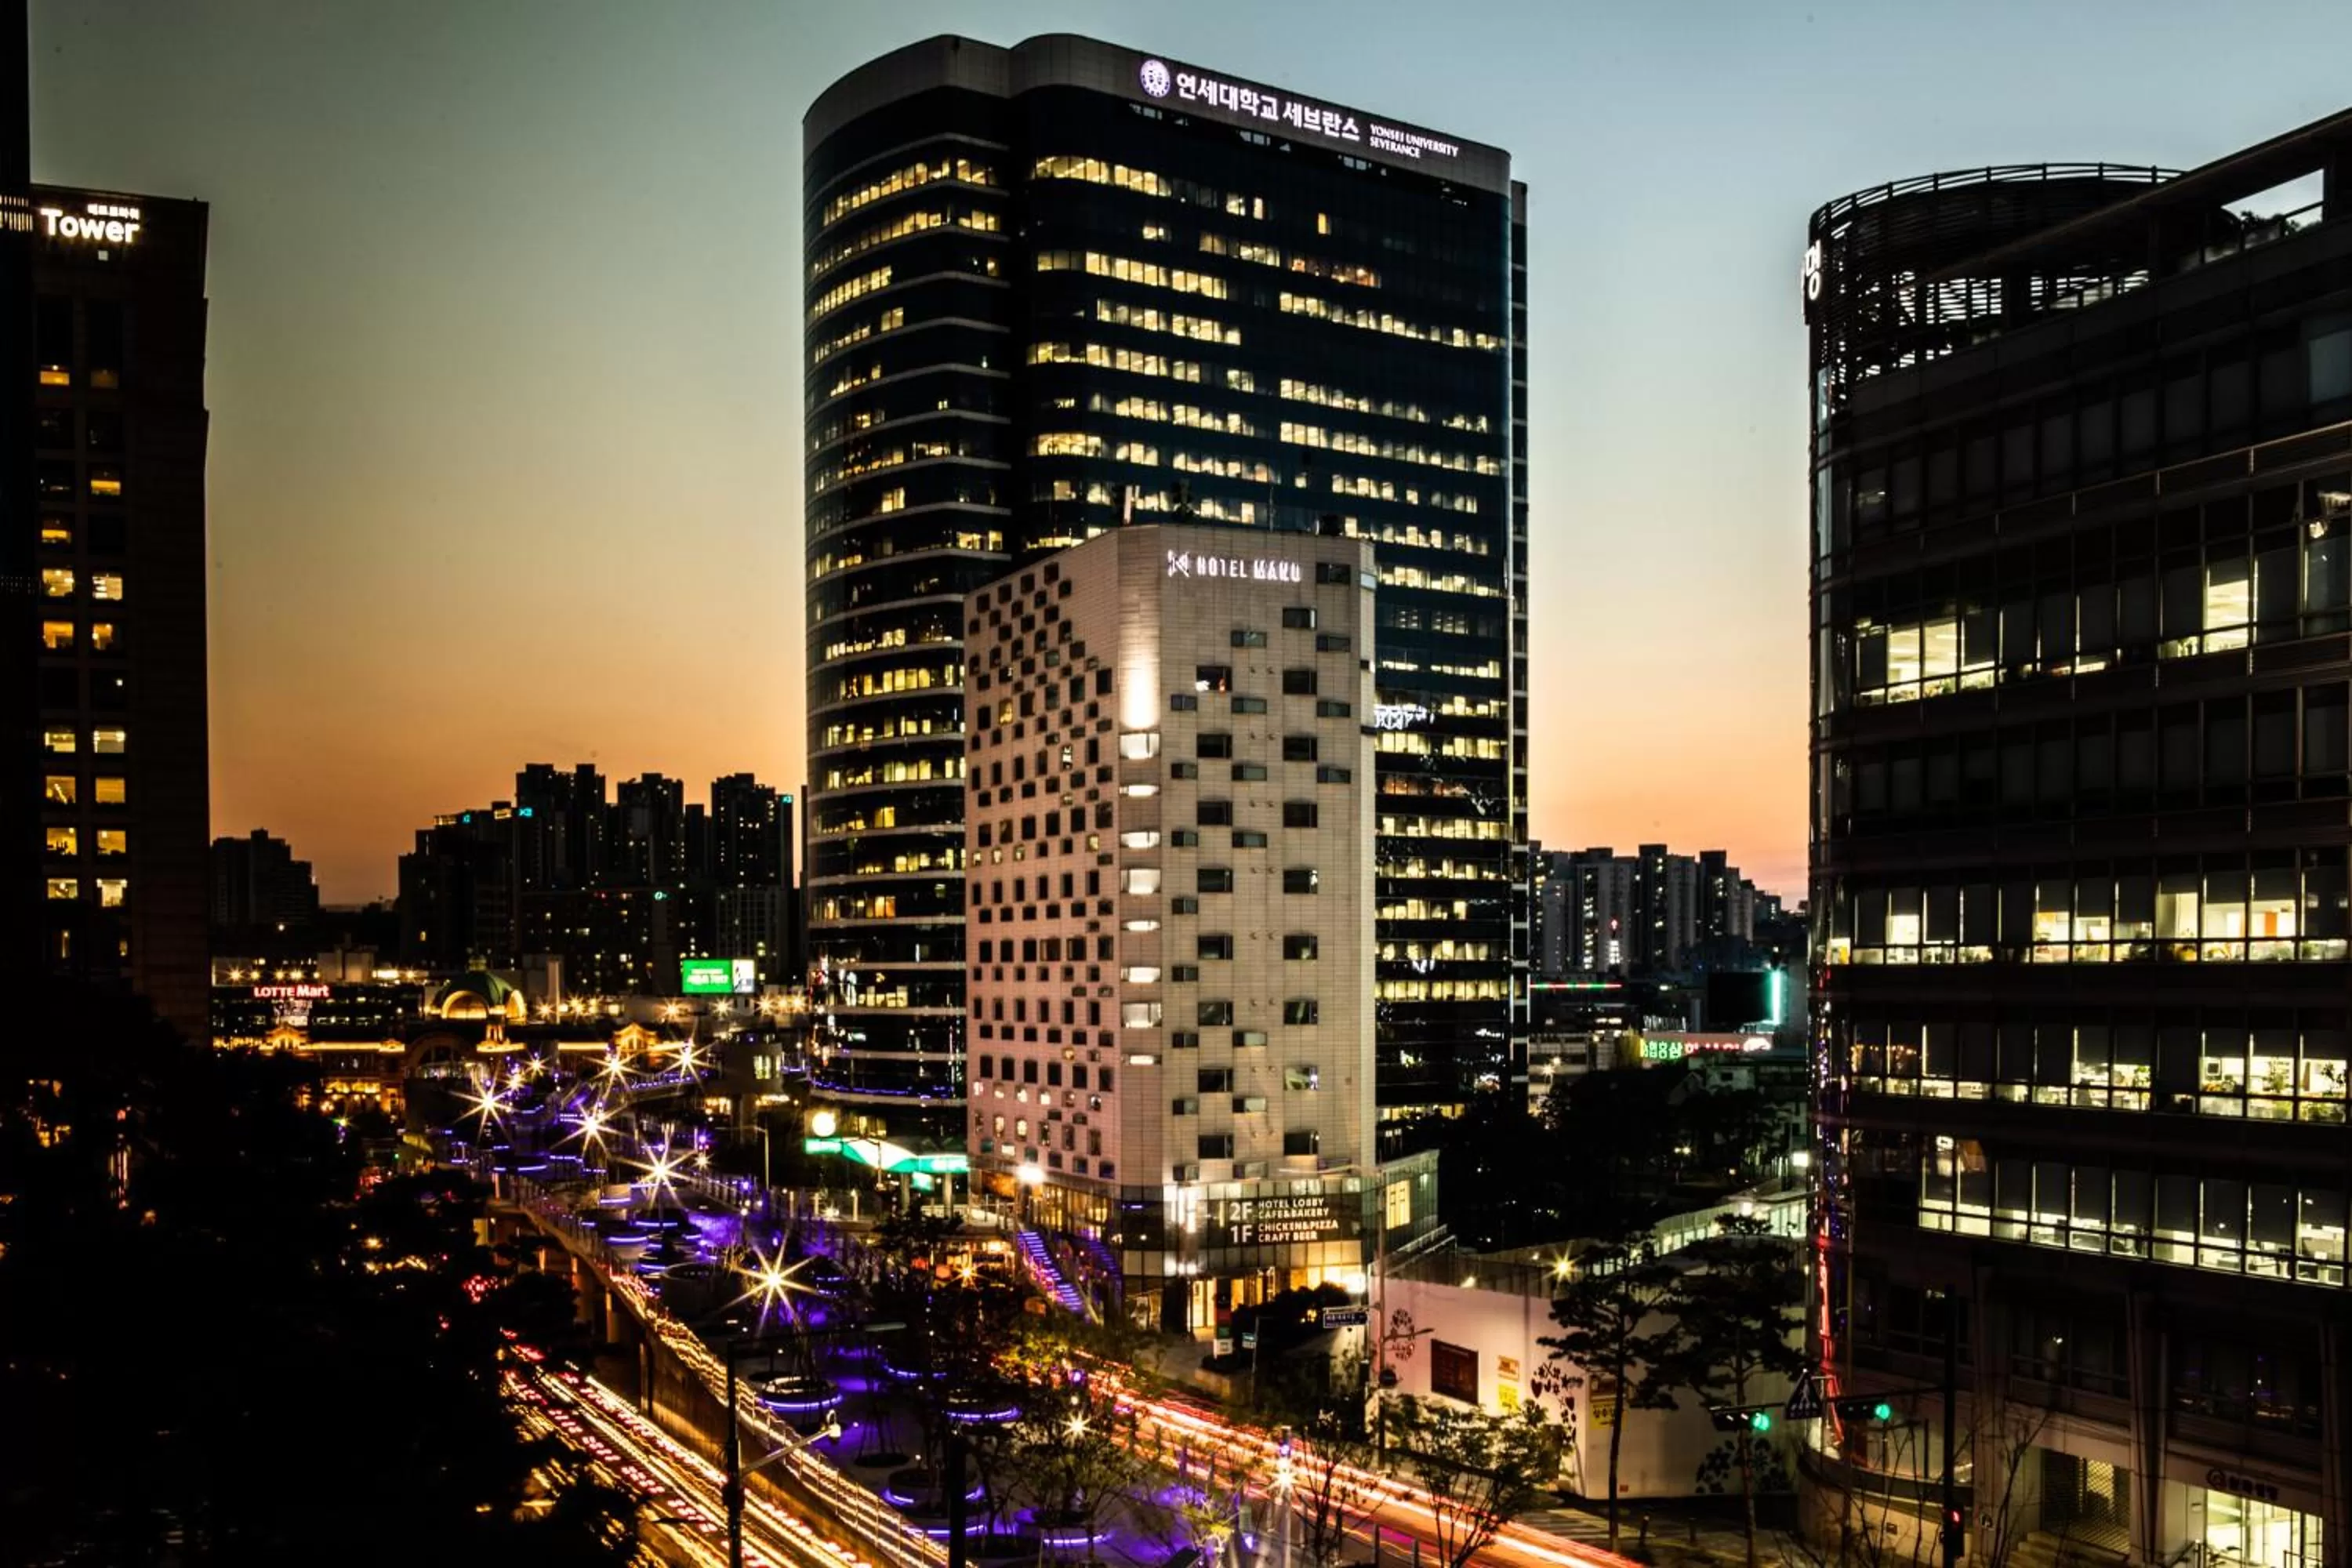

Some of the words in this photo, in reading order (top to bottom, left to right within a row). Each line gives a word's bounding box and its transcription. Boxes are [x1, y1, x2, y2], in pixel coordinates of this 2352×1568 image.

[1177, 73, 1279, 122] 연세대학교
[1283, 100, 1360, 142] 세브란스
[1370, 123, 1403, 143] YONSEI
[1406, 133, 1459, 157] UNIVERSITY
[1370, 136, 1421, 158] SEVERANCE
[40, 208, 140, 243] Tower
[1196, 556, 1247, 578] HOTEL
[254, 986, 295, 997] LOTTE
[296, 985, 329, 997] Mart
[1230, 1201, 1253, 1221] 2F
[1258, 1200, 1290, 1209] HOTEL
[1293, 1198, 1324, 1207] LOBBY
[1230, 1225, 1253, 1243] 1F
[1258, 1232, 1290, 1243] CRAFT
[1293, 1232, 1318, 1242] BEER
